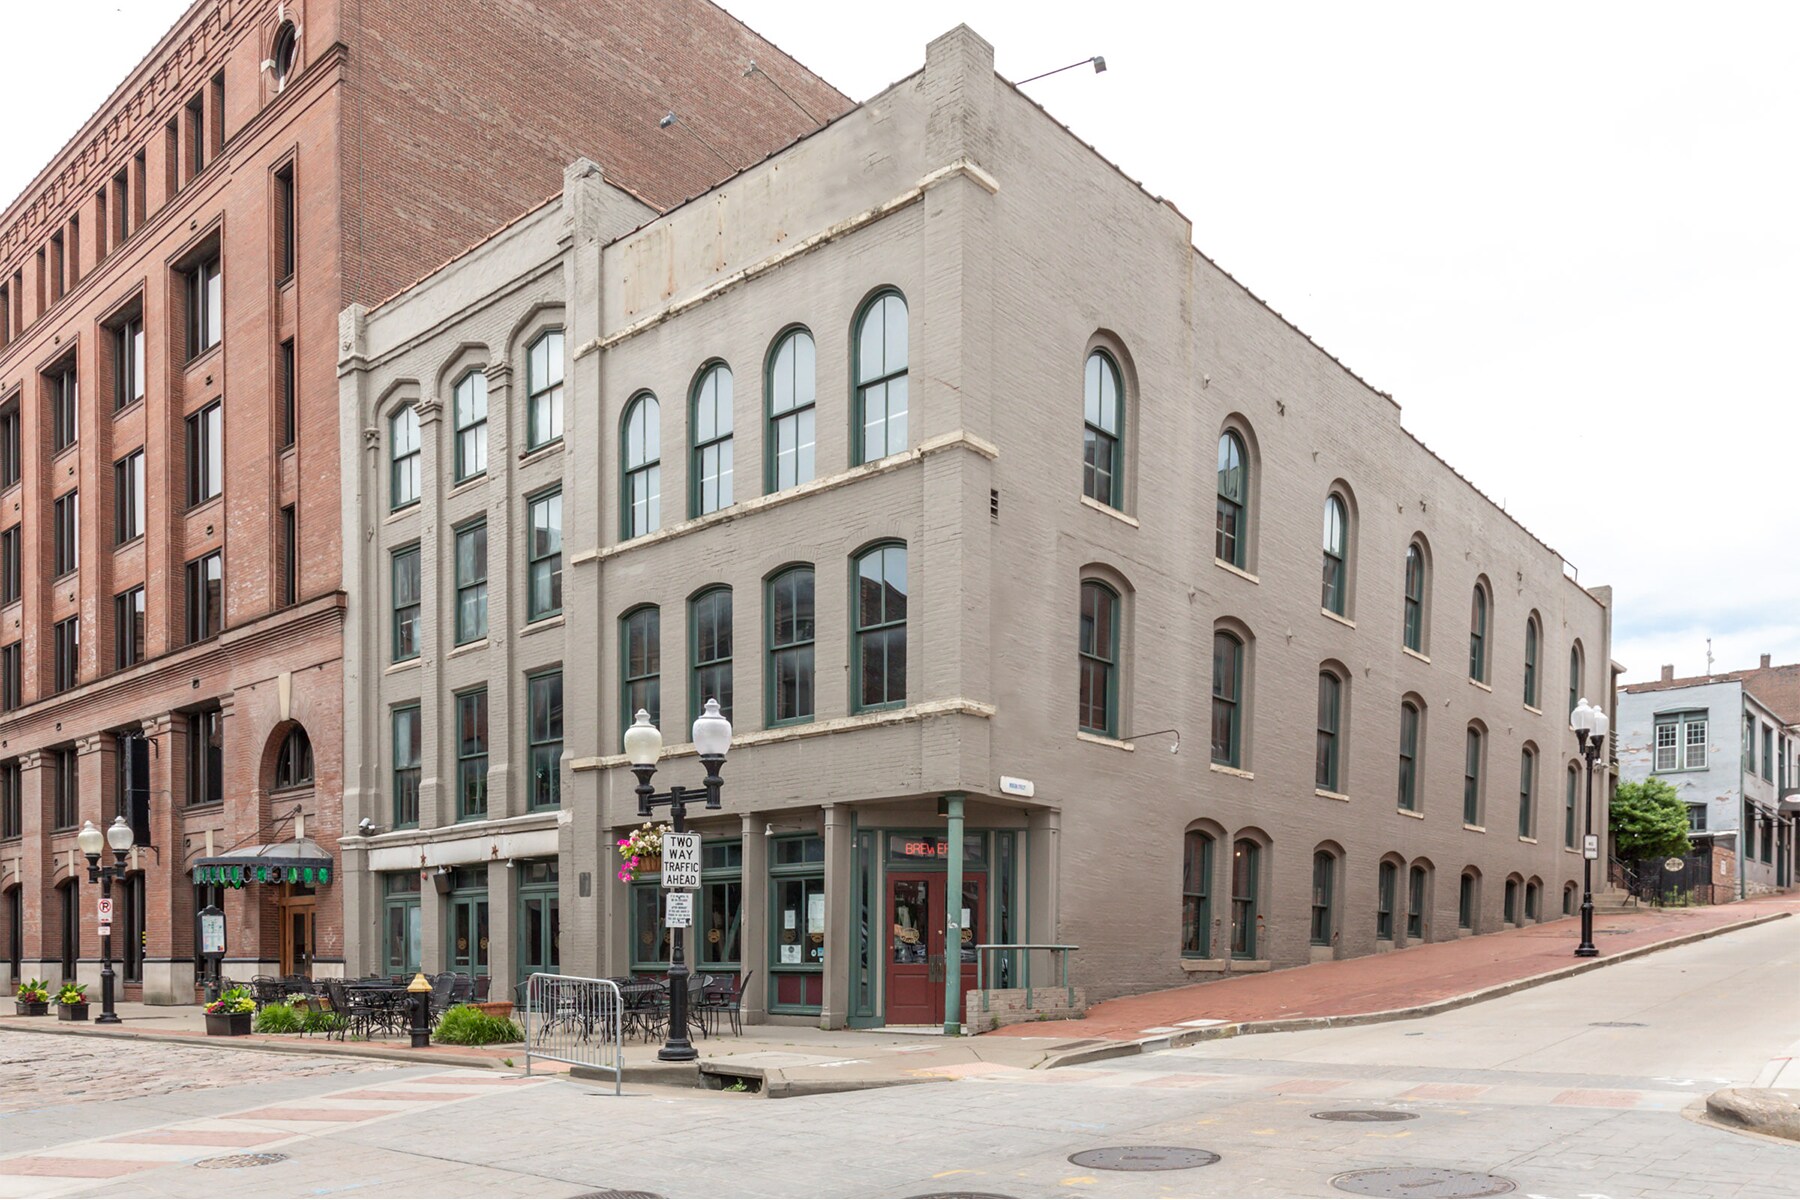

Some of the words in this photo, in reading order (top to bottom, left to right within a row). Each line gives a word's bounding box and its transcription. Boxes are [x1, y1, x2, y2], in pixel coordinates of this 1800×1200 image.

[670, 836, 693, 848] TWO
[669, 849, 694, 860] WAY
[664, 861, 699, 873] TRAFFIC
[666, 874, 697, 885] AHEAD
